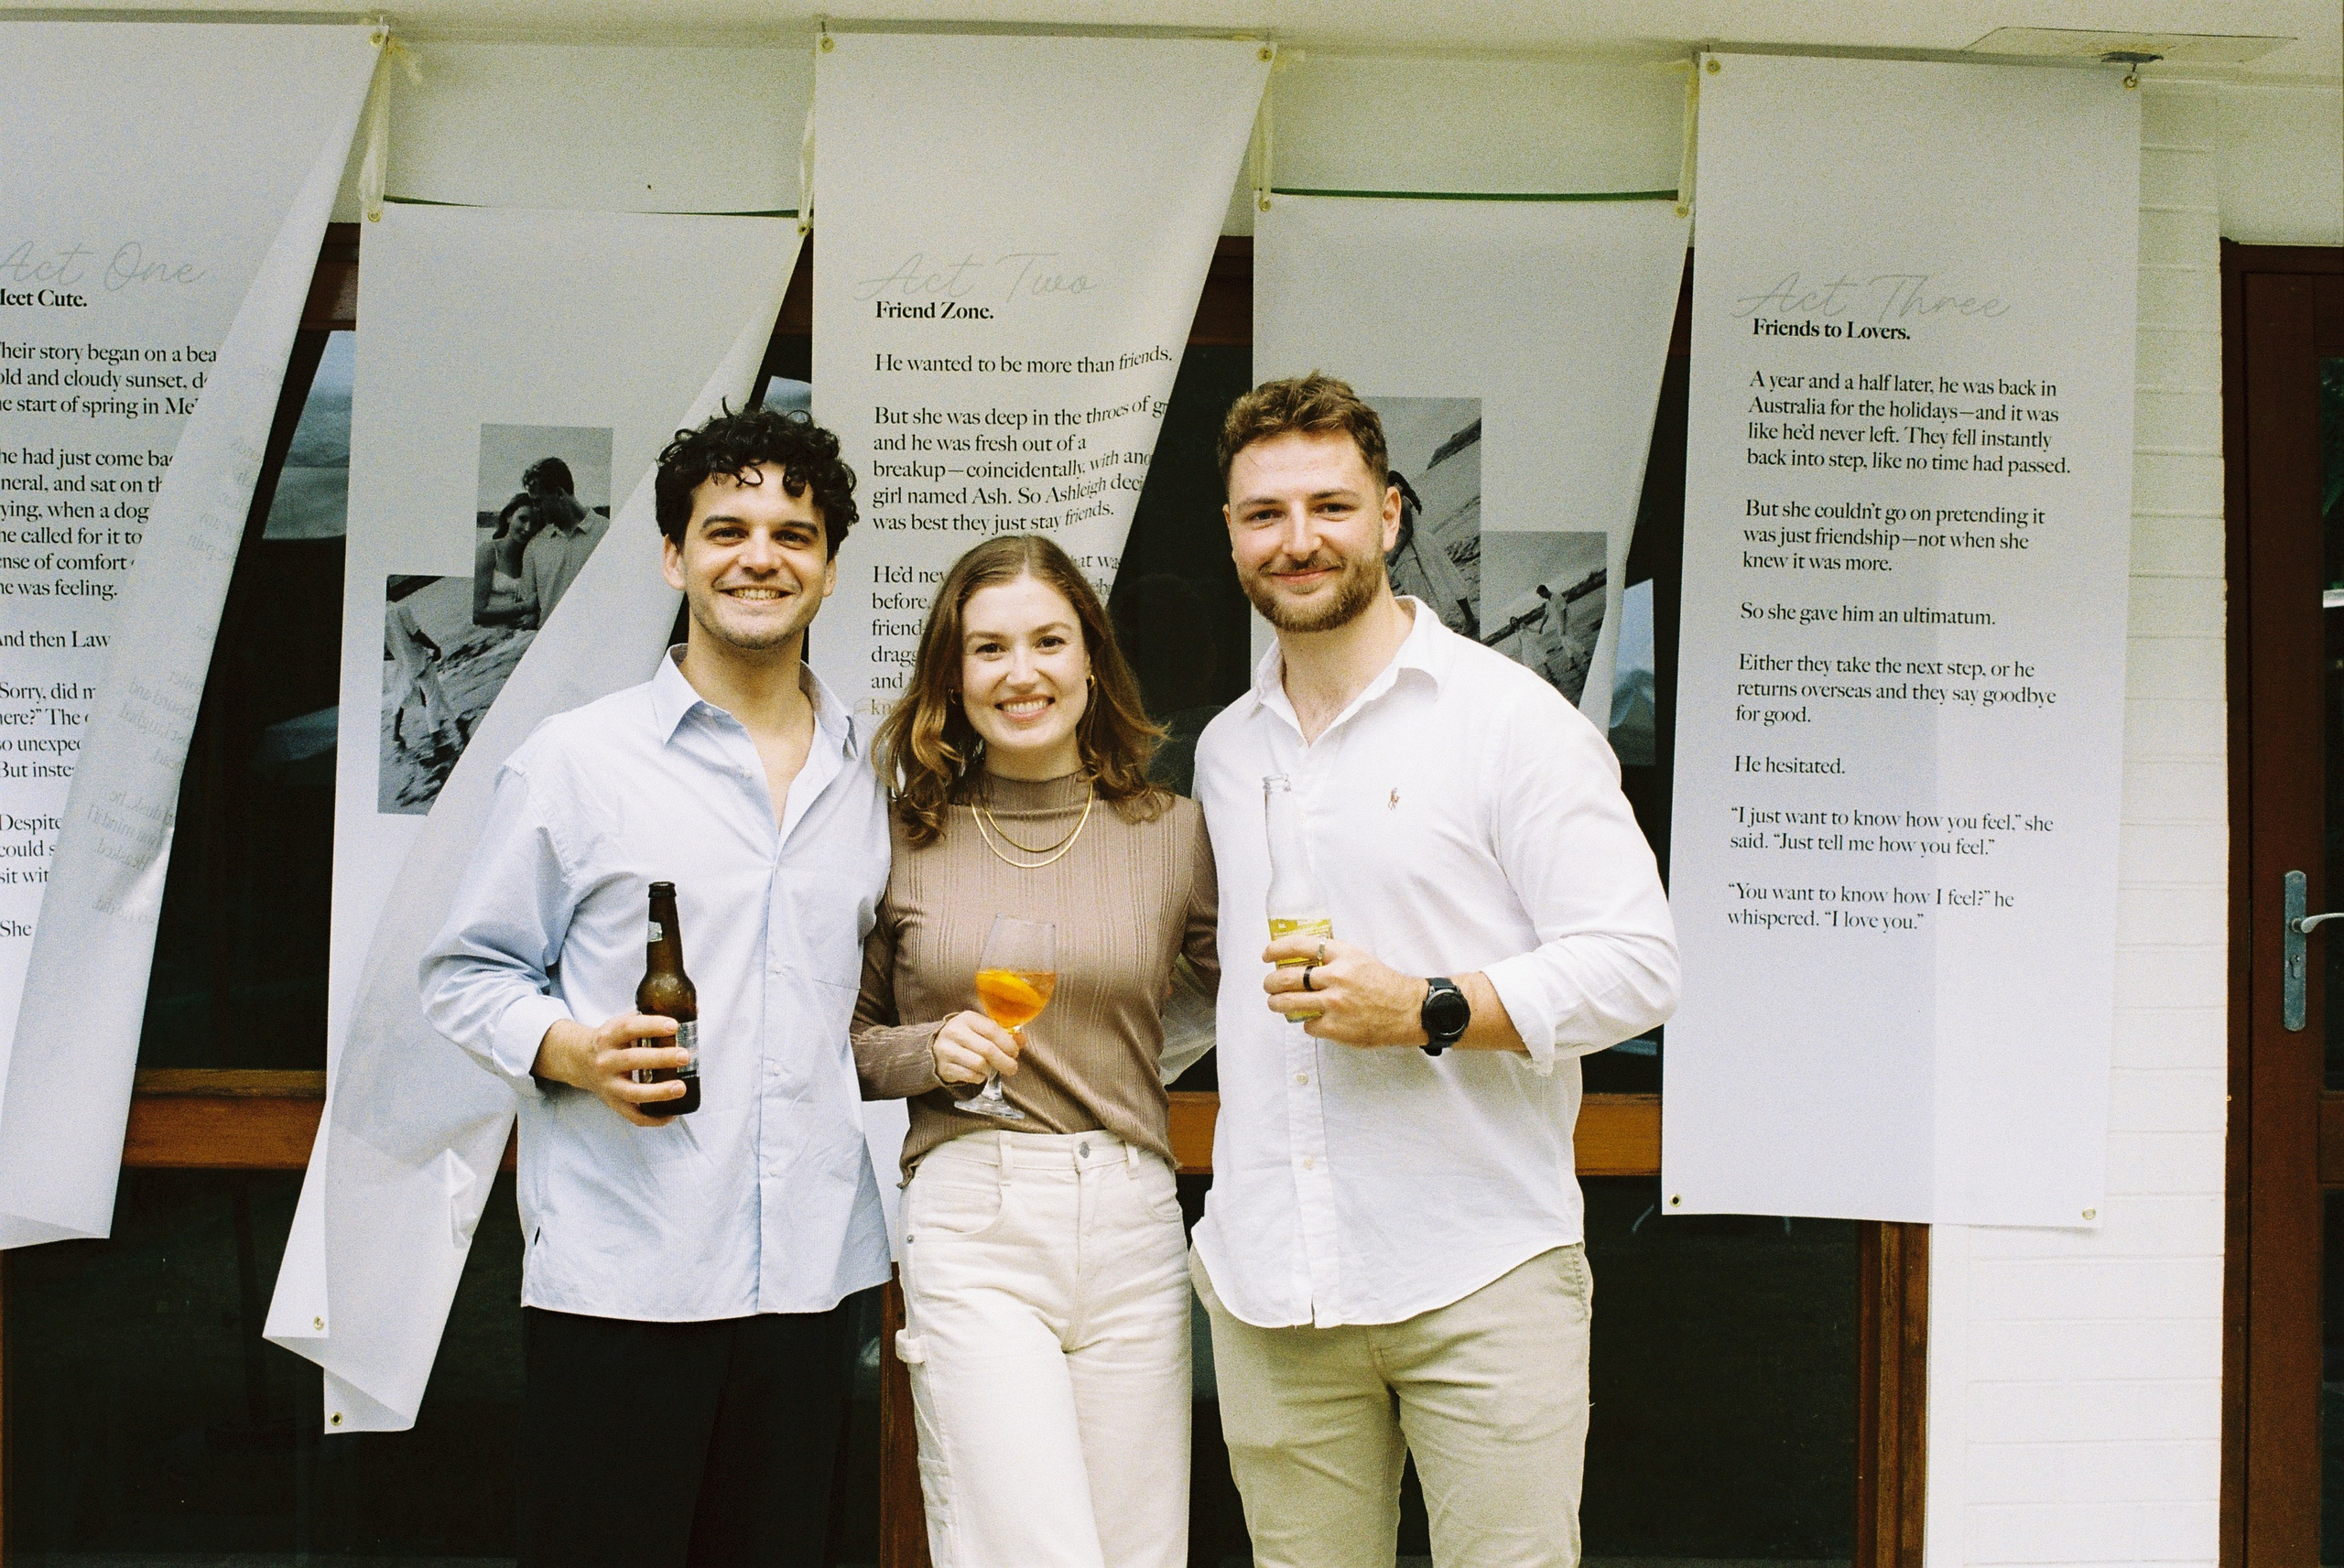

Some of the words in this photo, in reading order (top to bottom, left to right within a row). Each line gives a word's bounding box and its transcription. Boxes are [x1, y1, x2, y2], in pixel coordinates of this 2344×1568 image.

[0, 241, 93, 283] Act
[104, 241, 205, 292] One
[854, 253, 982, 301] Act
[996, 253, 1097, 302] Two
[38, 289, 87, 307] Cute.
[1731, 272, 1857, 318] Act
[1870, 274, 2011, 323] Three
[876, 301, 935, 319] Friend
[941, 302, 993, 319] Zone.
[1753, 319, 1819, 336] Friends
[1825, 324, 1842, 337] to
[1848, 321, 1910, 340] Lovers.
[40, 347, 80, 364] story
[88, 343, 139, 366] began
[876, 353, 903, 371] He
[907, 355, 971, 372] wanted
[1027, 361, 1072, 373] more
[1077, 356, 1114, 373] than
[1119, 345, 1172, 370] friends.
[27, 369, 59, 385] and
[64, 370, 118, 392] cloudy
[126, 375, 187, 389] sunset,
[1770, 375, 1805, 392] year
[1808, 373, 1839, 389] and
[1859, 373, 1892, 391] half
[1894, 374, 1934, 394] later,
[1963, 382, 1994, 395] was
[1999, 378, 2035, 395] back
[17, 399, 57, 412] start
[82, 397, 138, 419] spring
[875, 406, 908, 424] But
[913, 407, 942, 424] she
[947, 413, 981, 425] was
[984, 408, 1027, 430] deep
[1055, 409, 1081, 426] the
[1086, 406, 1129, 424] throes
[1749, 396, 1826, 415] Australia
[1830, 398, 1854, 416] for
[1859, 400, 1885, 416] the
[2027, 410, 2058, 422] was
[874, 434, 906, 450] and
[937, 439, 971, 451] was
[976, 434, 1017, 451] fresh
[1023, 439, 1052, 451] out
[1749, 422, 1778, 439] like
[1820, 429, 1865, 441] never
[1870, 426, 1899, 443] left.
[1904, 427, 1946, 449] They
[1953, 428, 1976, 445] fell
[1981, 430, 2049, 452] instantly
[23, 448, 54, 465] had
[57, 449, 92, 470] just
[95, 454, 143, 466] come
[1090, 450, 1119, 470] with
[1748, 448, 1785, 465] back
[1792, 449, 1825, 466] into
[1829, 454, 1867, 472] step,
[1872, 451, 1902, 469] like
[1932, 454, 1969, 470] time
[1973, 455, 2002, 471] had
[2008, 457, 2070, 477] passed.
[54, 475, 85, 492] and
[91, 480, 116, 492] sat
[1045, 477, 1107, 503] Ashleigh
[873, 487, 901, 508] girl
[908, 487, 967, 503] named
[972, 488, 1012, 504] Ash.
[48, 501, 94, 518] when
[114, 502, 149, 524] dog
[1065, 500, 1113, 525] friends.
[1746, 499, 1778, 516] But
[1783, 501, 1810, 517] she
[1937, 506, 2028, 529] pretending
[21, 526, 72, 544] called
[78, 527, 103, 545] for
[873, 518, 906, 530] was
[911, 514, 948, 530] best
[953, 514, 986, 535] they
[992, 514, 1026, 535] just
[1031, 516, 1058, 532] stay
[1743, 530, 1776, 542] was
[1777, 526, 1811, 547] just
[1950, 532, 1995, 548] when
[2001, 533, 2029, 549] she
[56, 553, 126, 570] comfort
[1743, 551, 1788, 568] knew
[1809, 557, 1840, 569] was
[1846, 558, 1892, 571] more.
[17, 584, 50, 595] was
[55, 579, 117, 600] feeling.
[1768, 603, 1796, 620] she
[1799, 609, 1838, 625] gave
[1843, 605, 1873, 622] him
[1904, 607, 1995, 624] ultimatum.
[29, 631, 66, 647] then
[1740, 654, 1793, 671] Either
[1797, 655, 1829, 676] they
[1837, 656, 1871, 673] take
[1875, 657, 1902, 674] the
[1906, 663, 1943, 675] next
[1948, 663, 1986, 680] step,
[50, 683, 78, 699] did
[872, 672, 903, 688] and
[1738, 684, 1797, 697] returns
[1801, 686, 1872, 697] overseas
[1876, 683, 1906, 698] and
[1913, 684, 1945, 705] they
[1953, 689, 1976, 706] say
[1982, 687, 2056, 708] goodbye
[45, 708, 81, 725] The
[1736, 704, 1760, 721] for
[1763, 706, 1810, 726] good.
[1735, 755, 1761, 772] He
[1766, 756, 1845, 773] hesitated.
[1747, 807, 1781, 827] just
[1785, 812, 1827, 825] want
[1854, 809, 1897, 826] know
[1906, 811, 1939, 827] how
[1948, 817, 1977, 833] you
[2025, 815, 2053, 831] she
[1731, 832, 1768, 849] said.
[1818, 834, 1843, 850] tell
[1880, 836, 1913, 851] how
[1921, 842, 1950, 858] you
[1773, 889, 1814, 901] want
[1841, 886, 1884, 902] know
[1894, 887, 1926, 903] how
[0, 921, 31, 936] She
[1728, 909, 1819, 930] whispered.
[1845, 911, 1878, 928] love
